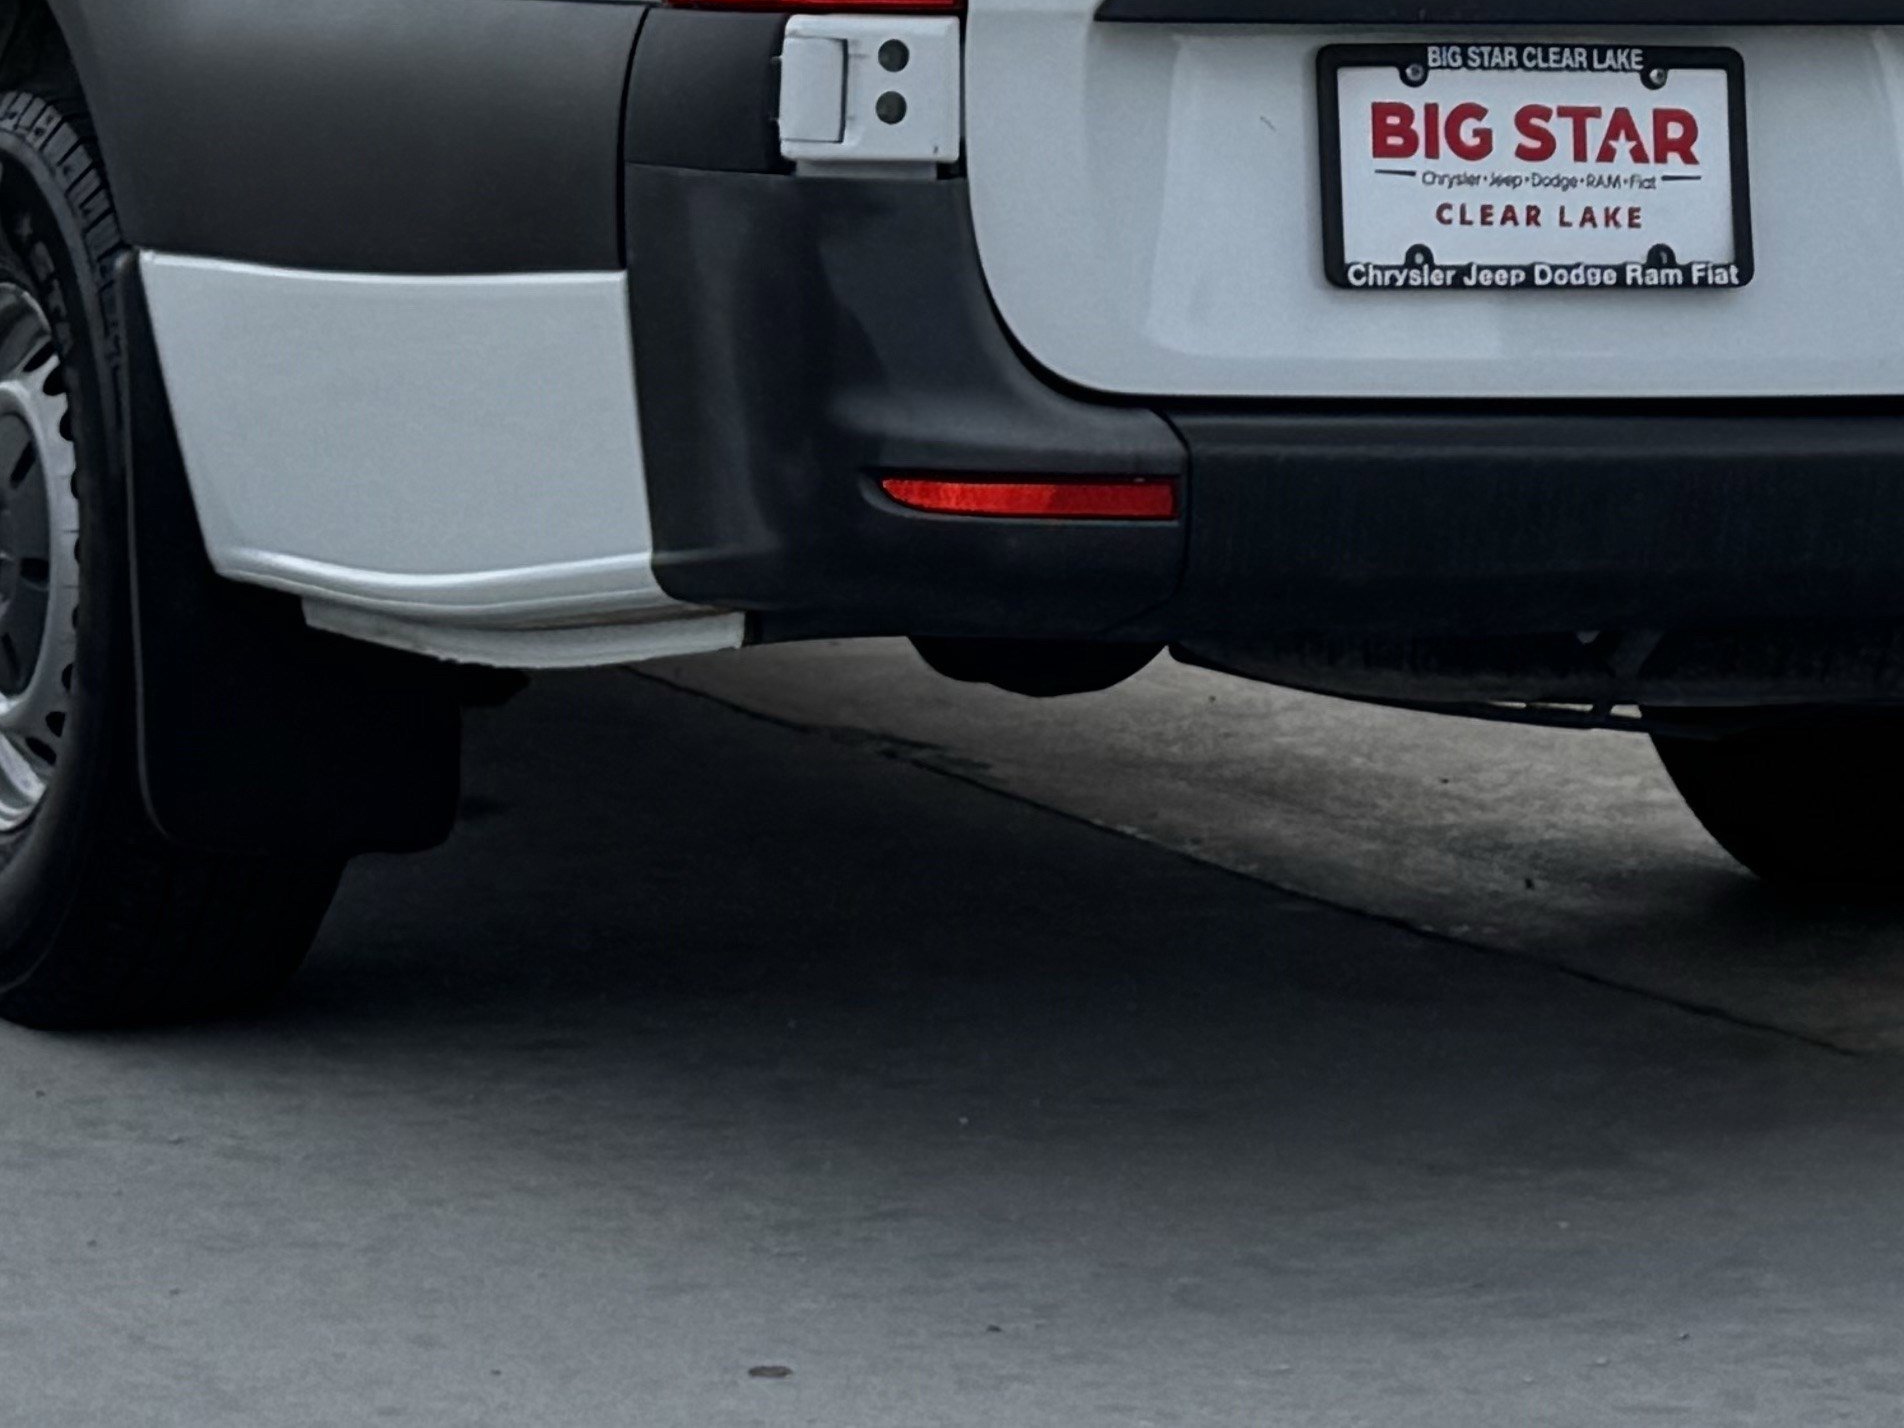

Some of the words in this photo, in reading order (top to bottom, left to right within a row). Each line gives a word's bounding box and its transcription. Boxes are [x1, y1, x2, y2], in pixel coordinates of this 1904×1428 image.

[1428, 46, 1462, 68] BIG
[1467, 46, 1518, 68] STAR
[1522, 47, 1587, 69] CLEAR
[1593, 48, 1644, 70] LAKE
[1371, 101, 1494, 161] BIG
[1514, 103, 1700, 165] STAR
[1435, 202, 1542, 227] CLEAR
[1558, 205, 1642, 229] LAKE
[1347, 264, 1456, 287] Chrysler
[1463, 264, 1527, 286] Jeep
[1534, 264, 1617, 286] Dodge
[1625, 264, 1684, 286] Ram
[1691, 263, 1741, 286] Fiat
